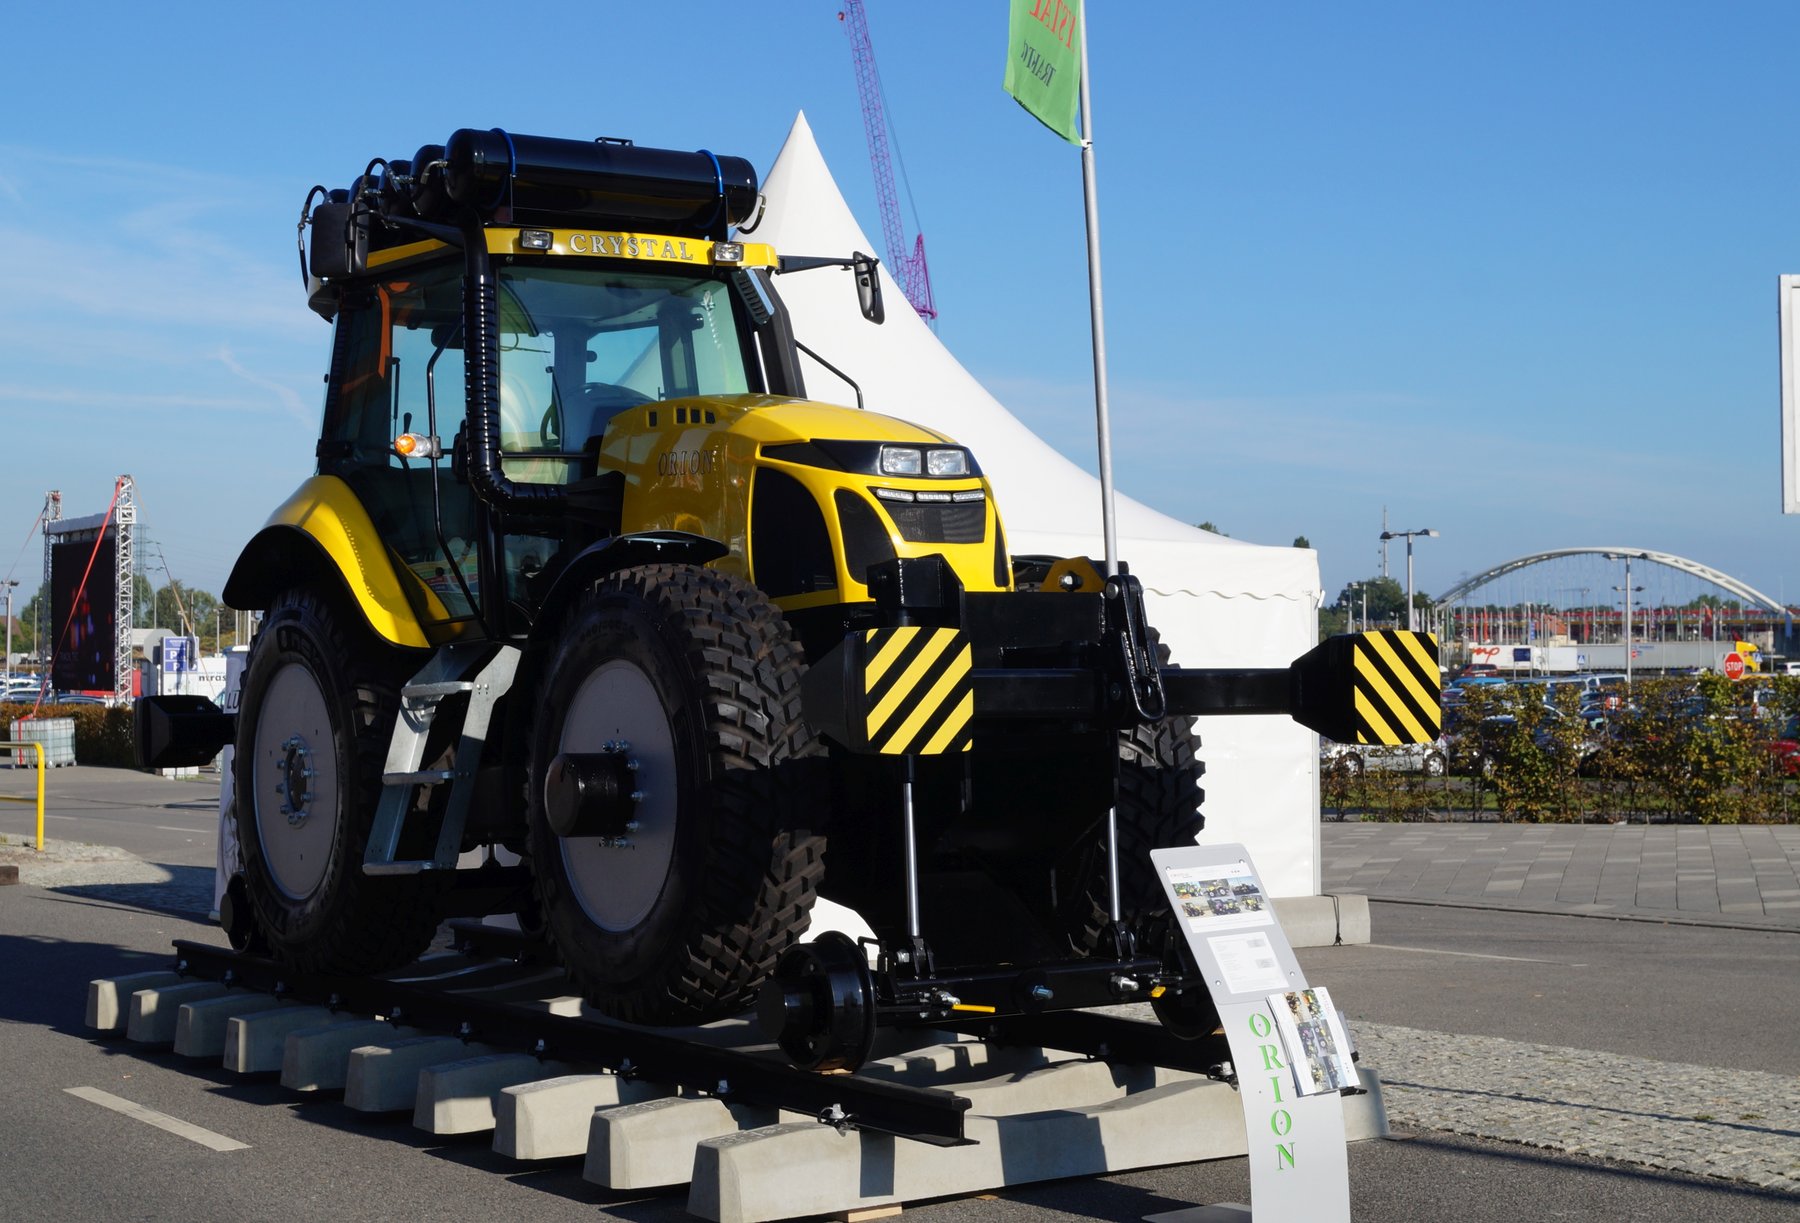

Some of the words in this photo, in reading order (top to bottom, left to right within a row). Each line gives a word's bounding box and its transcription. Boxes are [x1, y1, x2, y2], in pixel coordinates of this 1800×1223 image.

[569, 233, 693, 260] CRYSTAL
[658, 450, 713, 476] ORION
[1726, 661, 1743, 671] STOP
[1248, 1012, 1296, 1171] ORION
